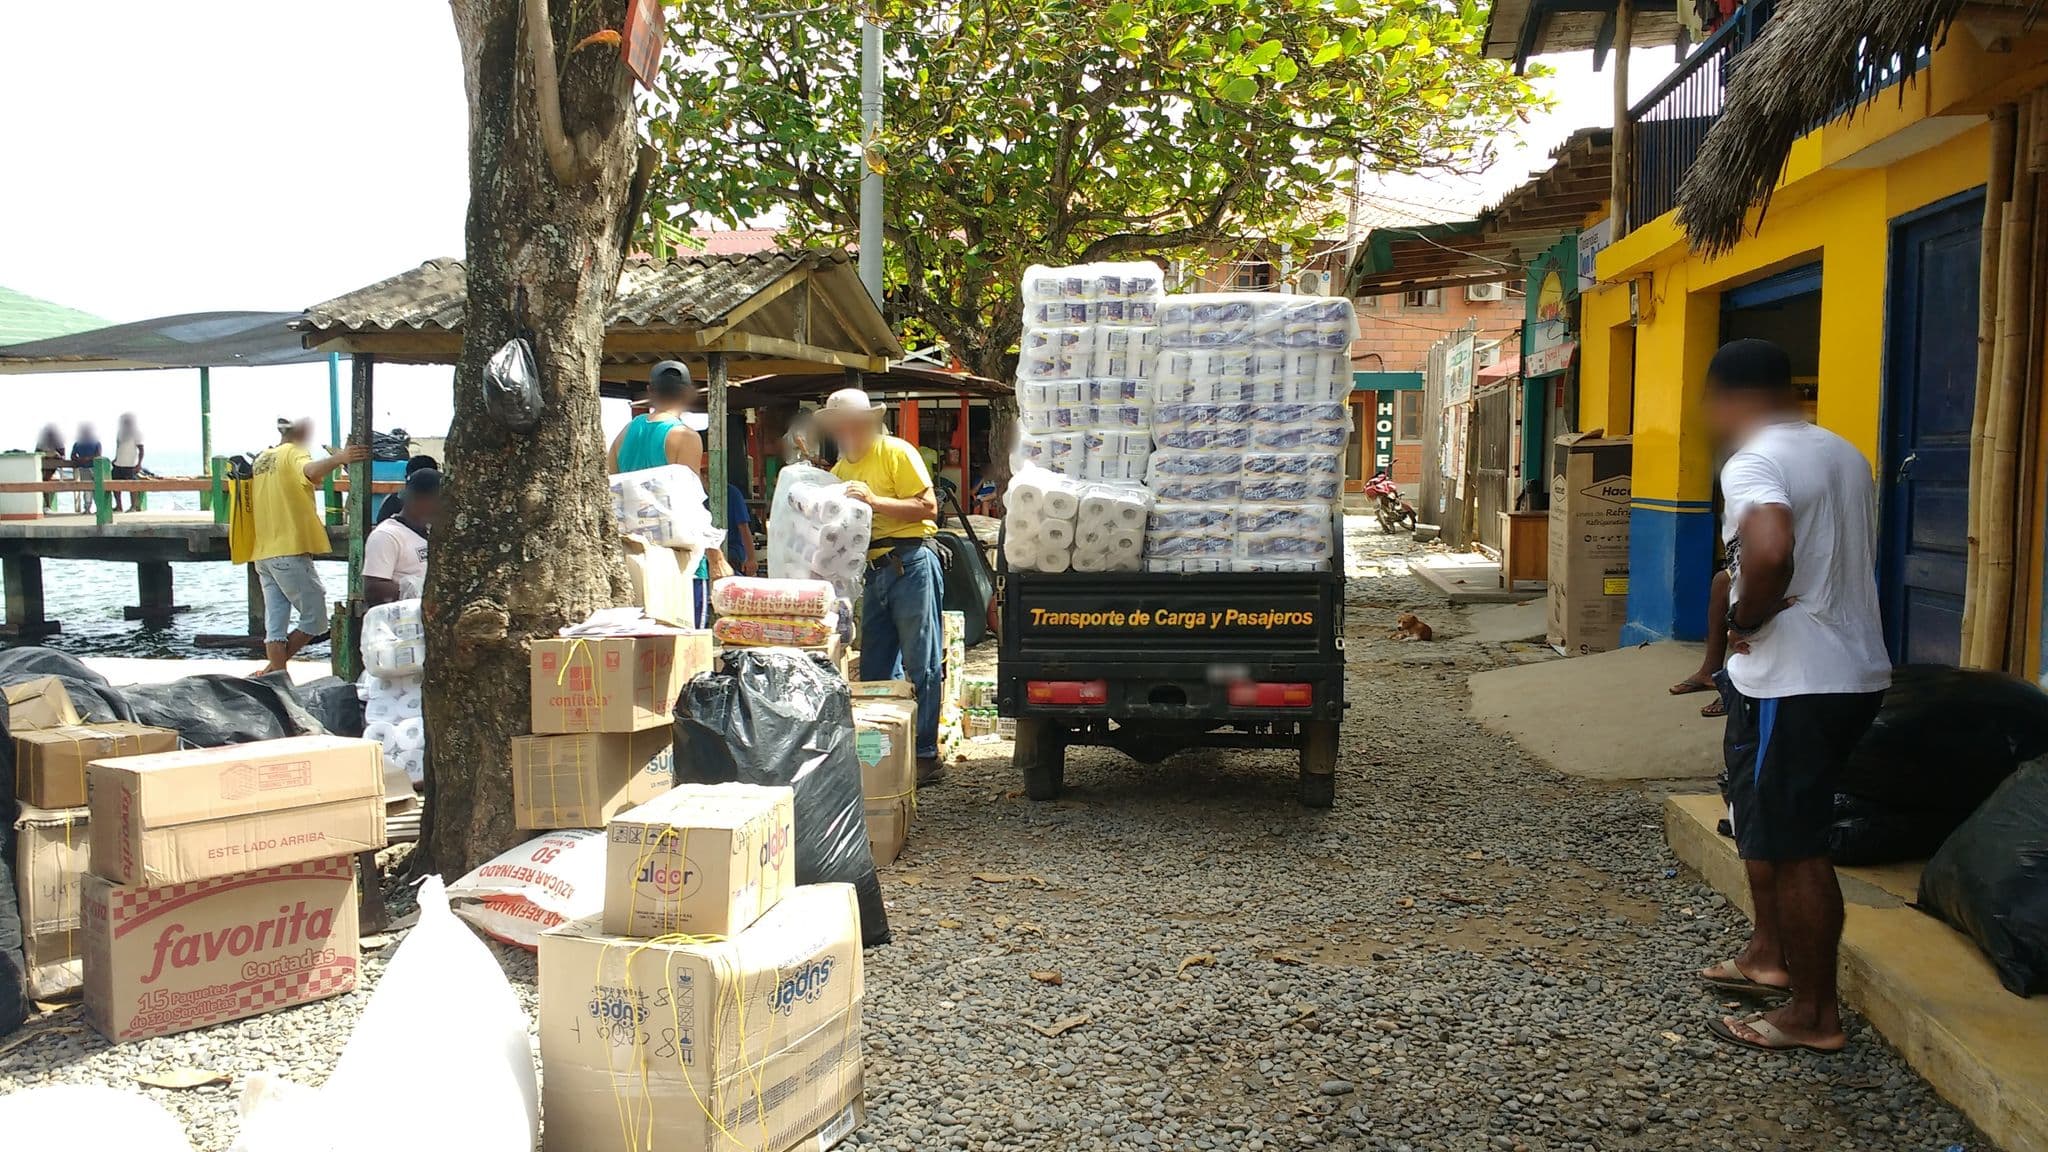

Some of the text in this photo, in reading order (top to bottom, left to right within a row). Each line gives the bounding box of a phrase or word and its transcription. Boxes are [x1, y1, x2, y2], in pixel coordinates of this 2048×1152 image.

[1377, 403, 1393, 467] HOTE
[1030, 608, 1313, 629] Transporte de Carga y Pasajeros
[120, 785, 132, 880] favorita
[208, 831, 327, 859] ESTE LADO ARRIBA
[760, 822, 790, 868] aldor
[530, 847, 561, 864] 50
[479, 864, 534, 883] REFINADO
[637, 860, 693, 885] aldor
[140, 901, 334, 984] favorita
[241, 948, 336, 981] Cortadas
[137, 984, 230, 1014] 15 Paquetes
[769, 957, 835, 1014] super
[130, 997, 237, 1030] de 320 Servilletas
[590, 998, 650, 1025] super
